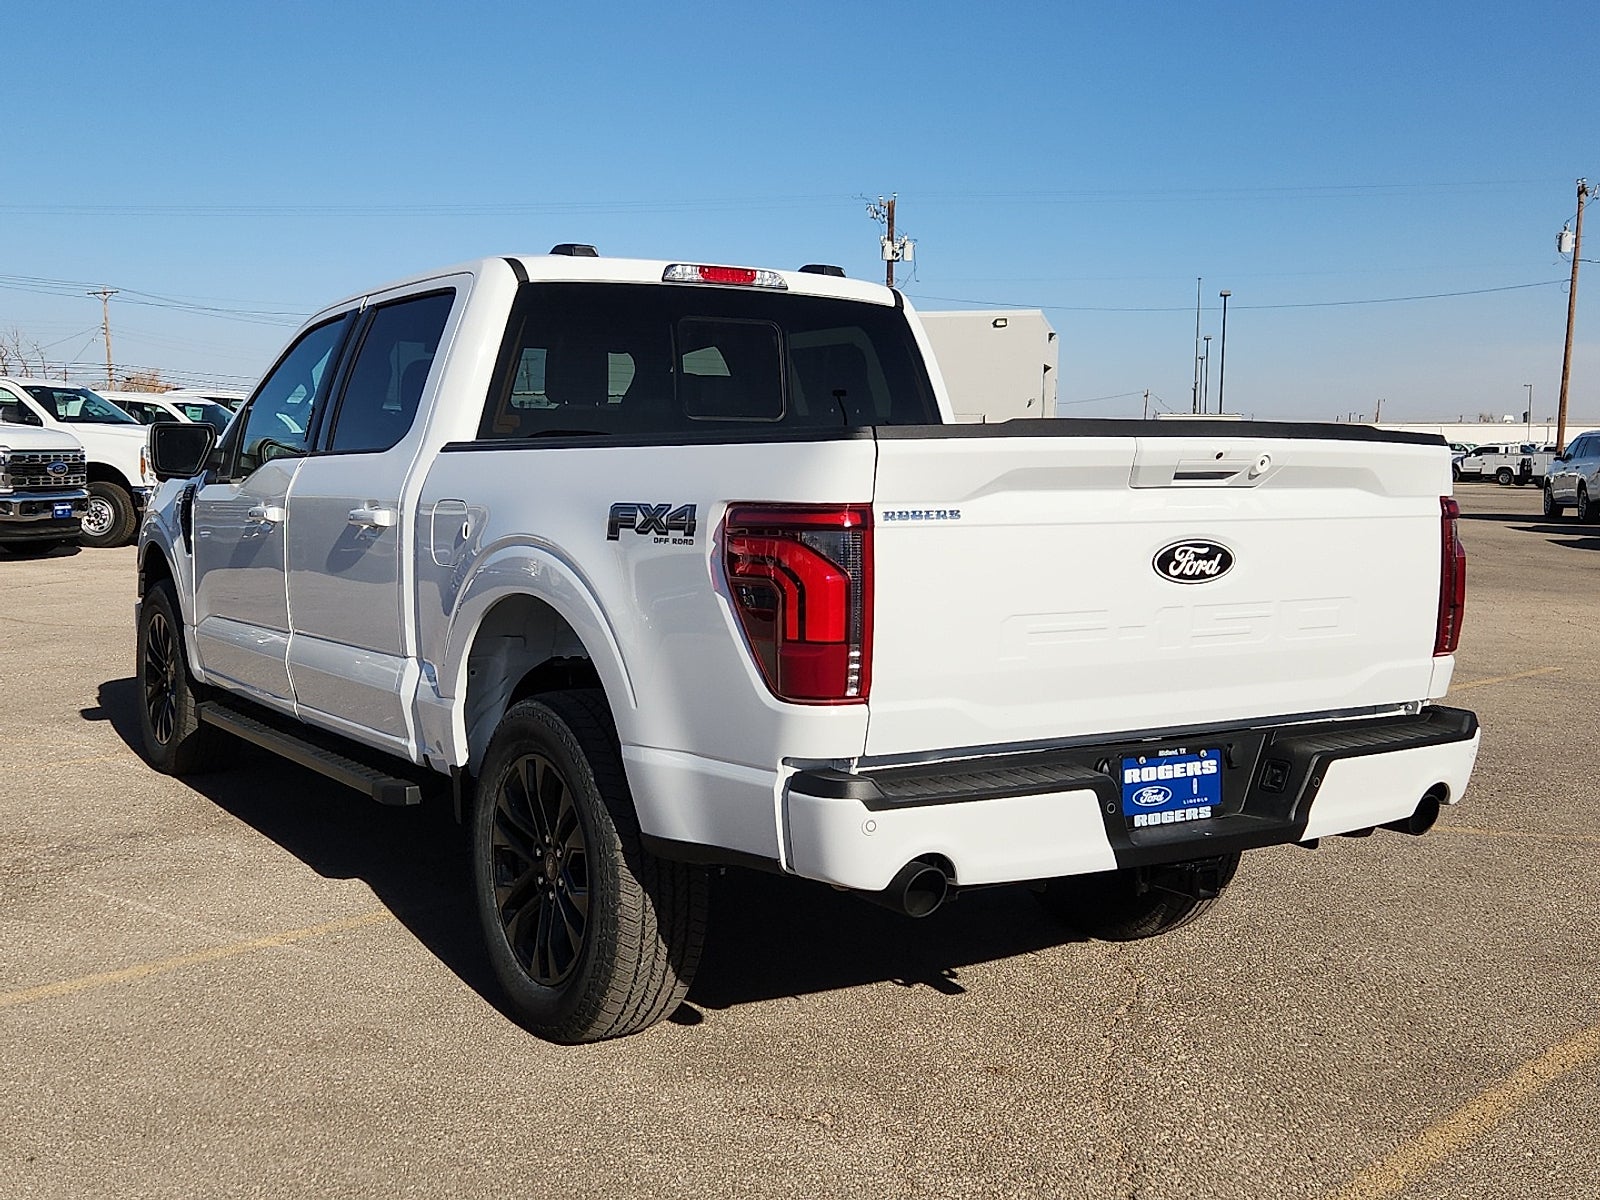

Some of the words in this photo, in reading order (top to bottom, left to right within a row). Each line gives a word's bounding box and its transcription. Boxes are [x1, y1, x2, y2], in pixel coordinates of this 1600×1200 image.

[606, 502, 697, 541] FX4
[672, 538, 694, 546] ROAD
[1168, 546, 1223, 576] Ford
[999, 596, 1358, 661] F-150
[1124, 759, 1218, 784] ROGERS
[1139, 788, 1165, 804] Ford
[1133, 805, 1212, 828] ROGERS
